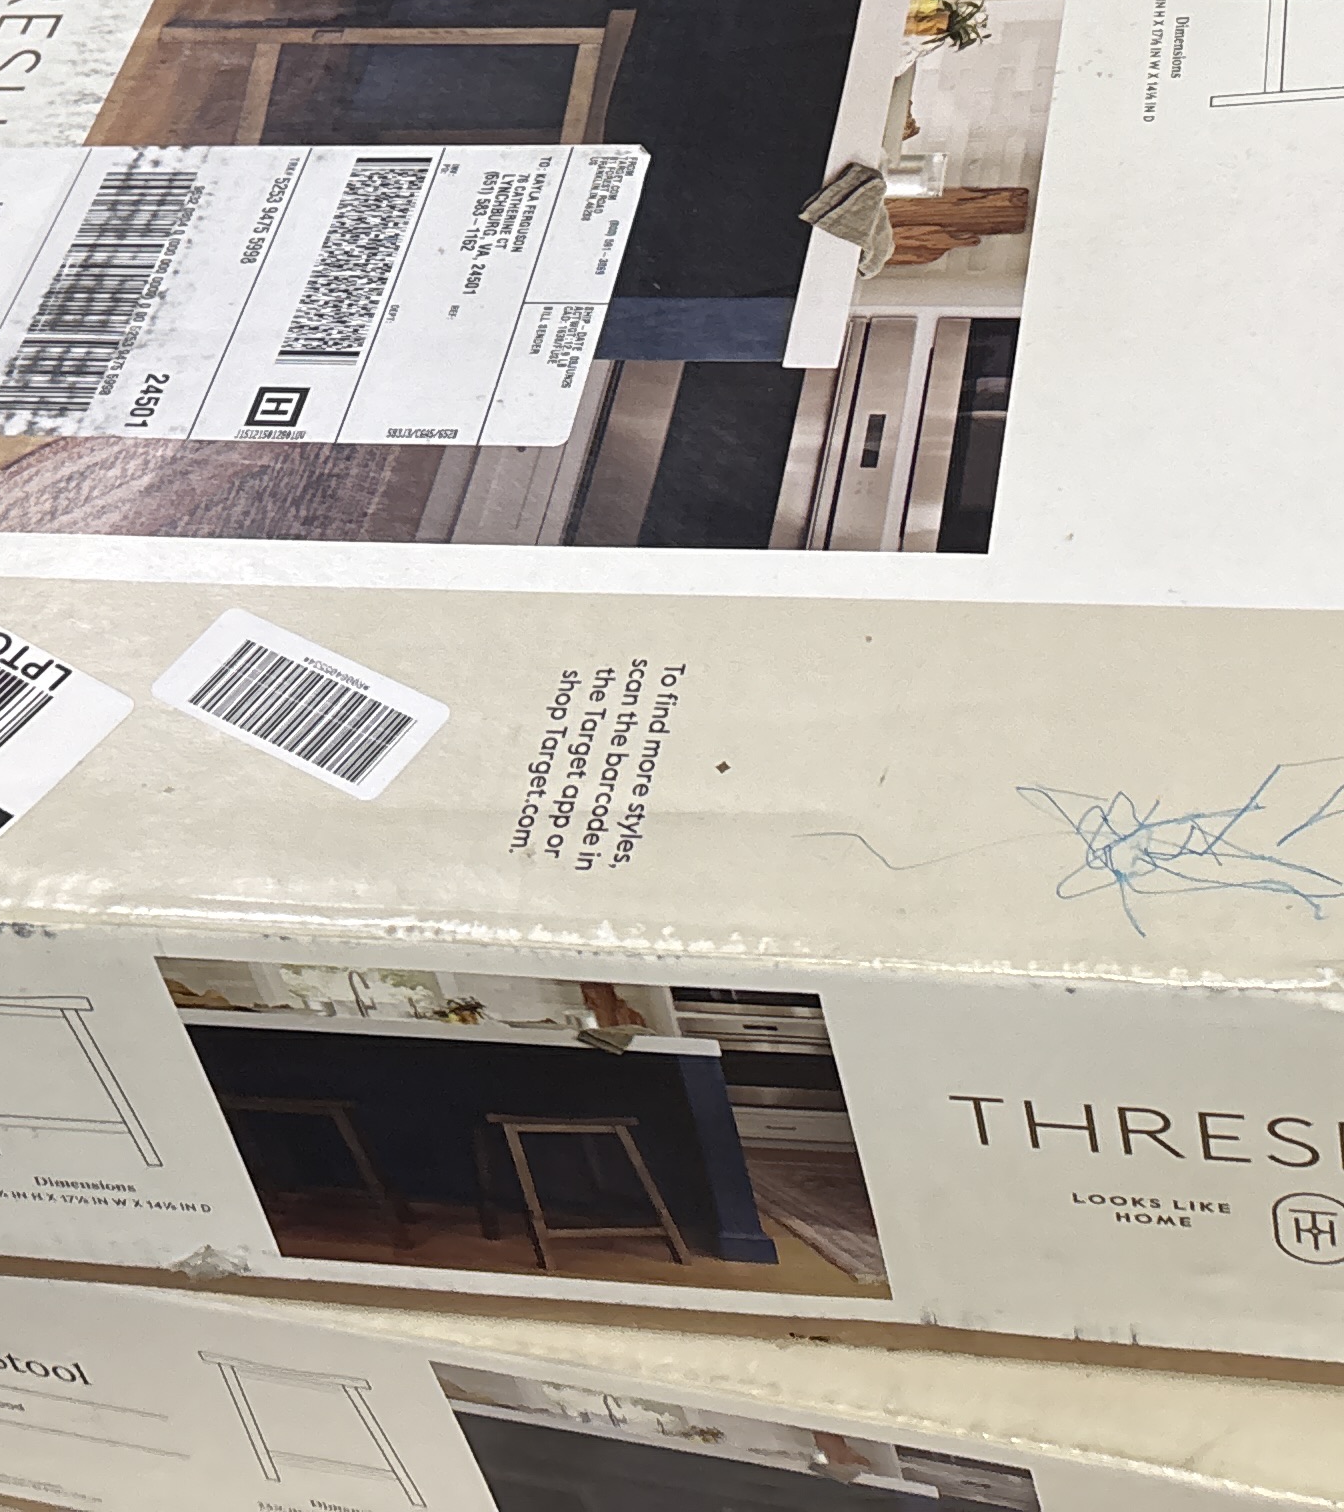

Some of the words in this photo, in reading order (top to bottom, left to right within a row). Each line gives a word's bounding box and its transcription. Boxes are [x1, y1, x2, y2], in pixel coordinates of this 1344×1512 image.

[1169, 15, 1190, 78] Dimensions
[264, 177, 291, 203] 5253
[475, 171, 500, 194] (651)
[515, 173, 530, 183] 76
[525, 173, 547, 202] KAYLA
[251, 206, 279, 234] 9475
[477, 173, 516, 240] LYNCHBURG,
[498, 185, 527, 235] CATHERINE
[493, 237, 510, 249] CT
[509, 204, 537, 253] FERGUSON
[238, 236, 267, 264] 5998
[471, 243, 492, 261] VA,
[461, 263, 485, 295] 24501
[122, 372, 172, 428] 24501
[586, 667, 619, 702] the
[618, 658, 651, 705] scan
[658, 664, 687, 687] To
[543, 669, 585, 721] shop
[644, 692, 681, 733] find
[558, 707, 608, 779] Target
[608, 710, 642, 747] the
[627, 739, 666, 797] more
[501, 725, 568, 856] Target.com.
[544, 783, 582, 829] app
[578, 752, 633, 847] barcode
[542, 833, 566, 858] or
[602, 801, 649, 871] styles,
[573, 849, 602, 873] in
[34, 1173, 136, 1196] Dimensions
[1071, 1192, 1163, 1213] LOOKS
[1172, 1198, 1233, 1217] LIKE
[1114, 1211, 1194, 1230] HOME
